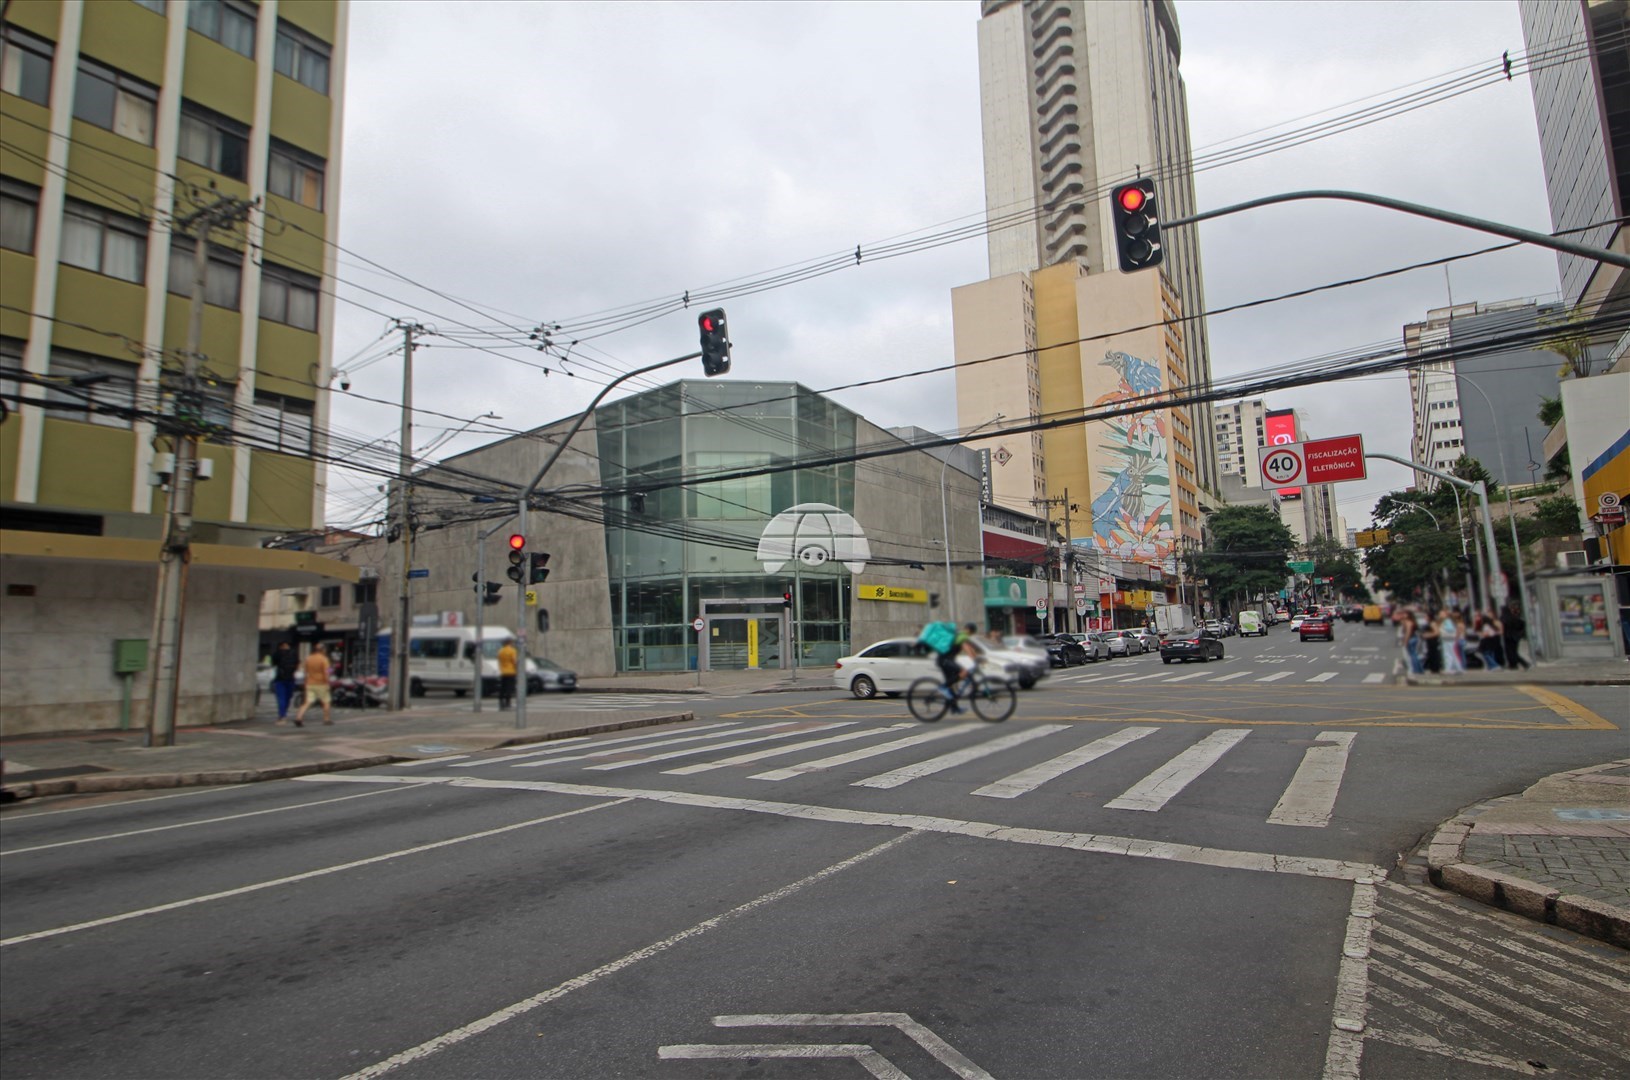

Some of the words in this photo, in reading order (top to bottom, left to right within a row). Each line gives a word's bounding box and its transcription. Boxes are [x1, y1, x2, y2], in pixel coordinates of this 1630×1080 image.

[1308, 447, 1357, 460] FISCALIZAÇÃO
[1269, 457, 1293, 472] 40
[1312, 461, 1355, 472] ELETRÔNICA
